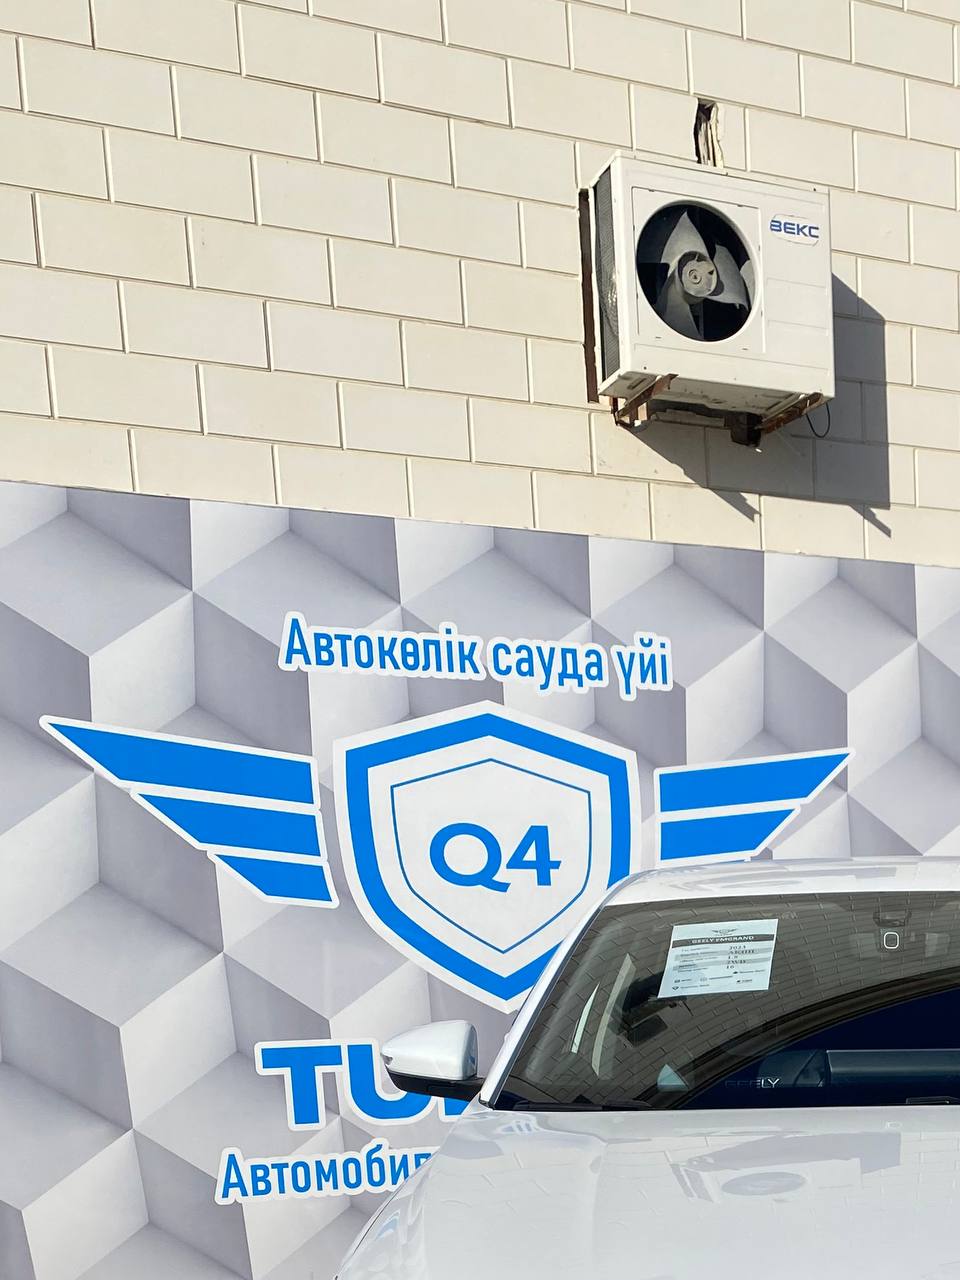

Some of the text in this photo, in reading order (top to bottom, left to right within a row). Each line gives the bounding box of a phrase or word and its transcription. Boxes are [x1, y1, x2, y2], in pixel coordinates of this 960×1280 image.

[285, 618, 669, 695] Автокөлік сауда үйі
[430, 822, 562, 893] Q4
[261, 1044, 472, 1124] TU
